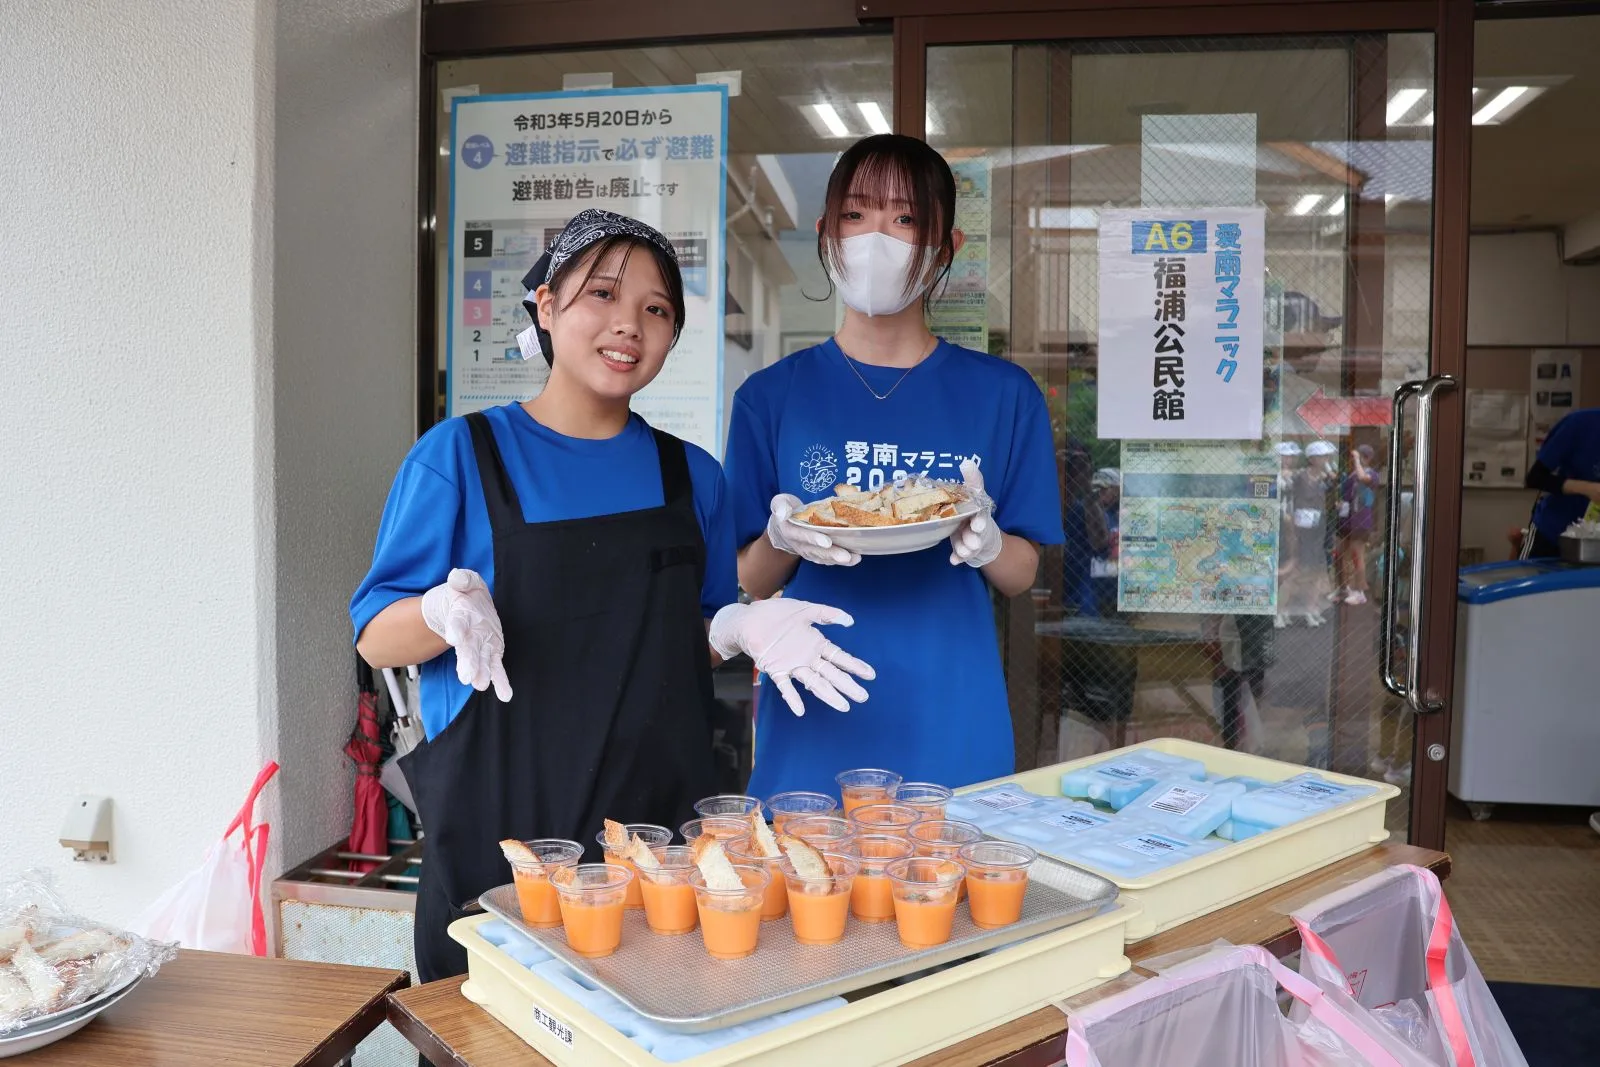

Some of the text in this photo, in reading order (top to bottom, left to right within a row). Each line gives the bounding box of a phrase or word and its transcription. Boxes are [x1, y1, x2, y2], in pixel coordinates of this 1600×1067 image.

[513, 109, 673, 131] 令和3年5月20日から
[473, 153, 483, 165] 4
[505, 135, 714, 166] 避難指示で必ず避難
[512, 177, 679, 201] 避難勧告は廃止です
[474, 237, 483, 250] 5
[1145, 222, 1193, 251] A6
[473, 279, 482, 292] 4
[473, 307, 482, 319] 3
[1214, 223, 1242, 384] 愛南マラニック
[473, 330, 482, 343] 2
[1153, 257, 1187, 421] 福浦公民館
[473, 350, 479, 362] 1
[534, 1006, 573, 1045] 商工観光課
